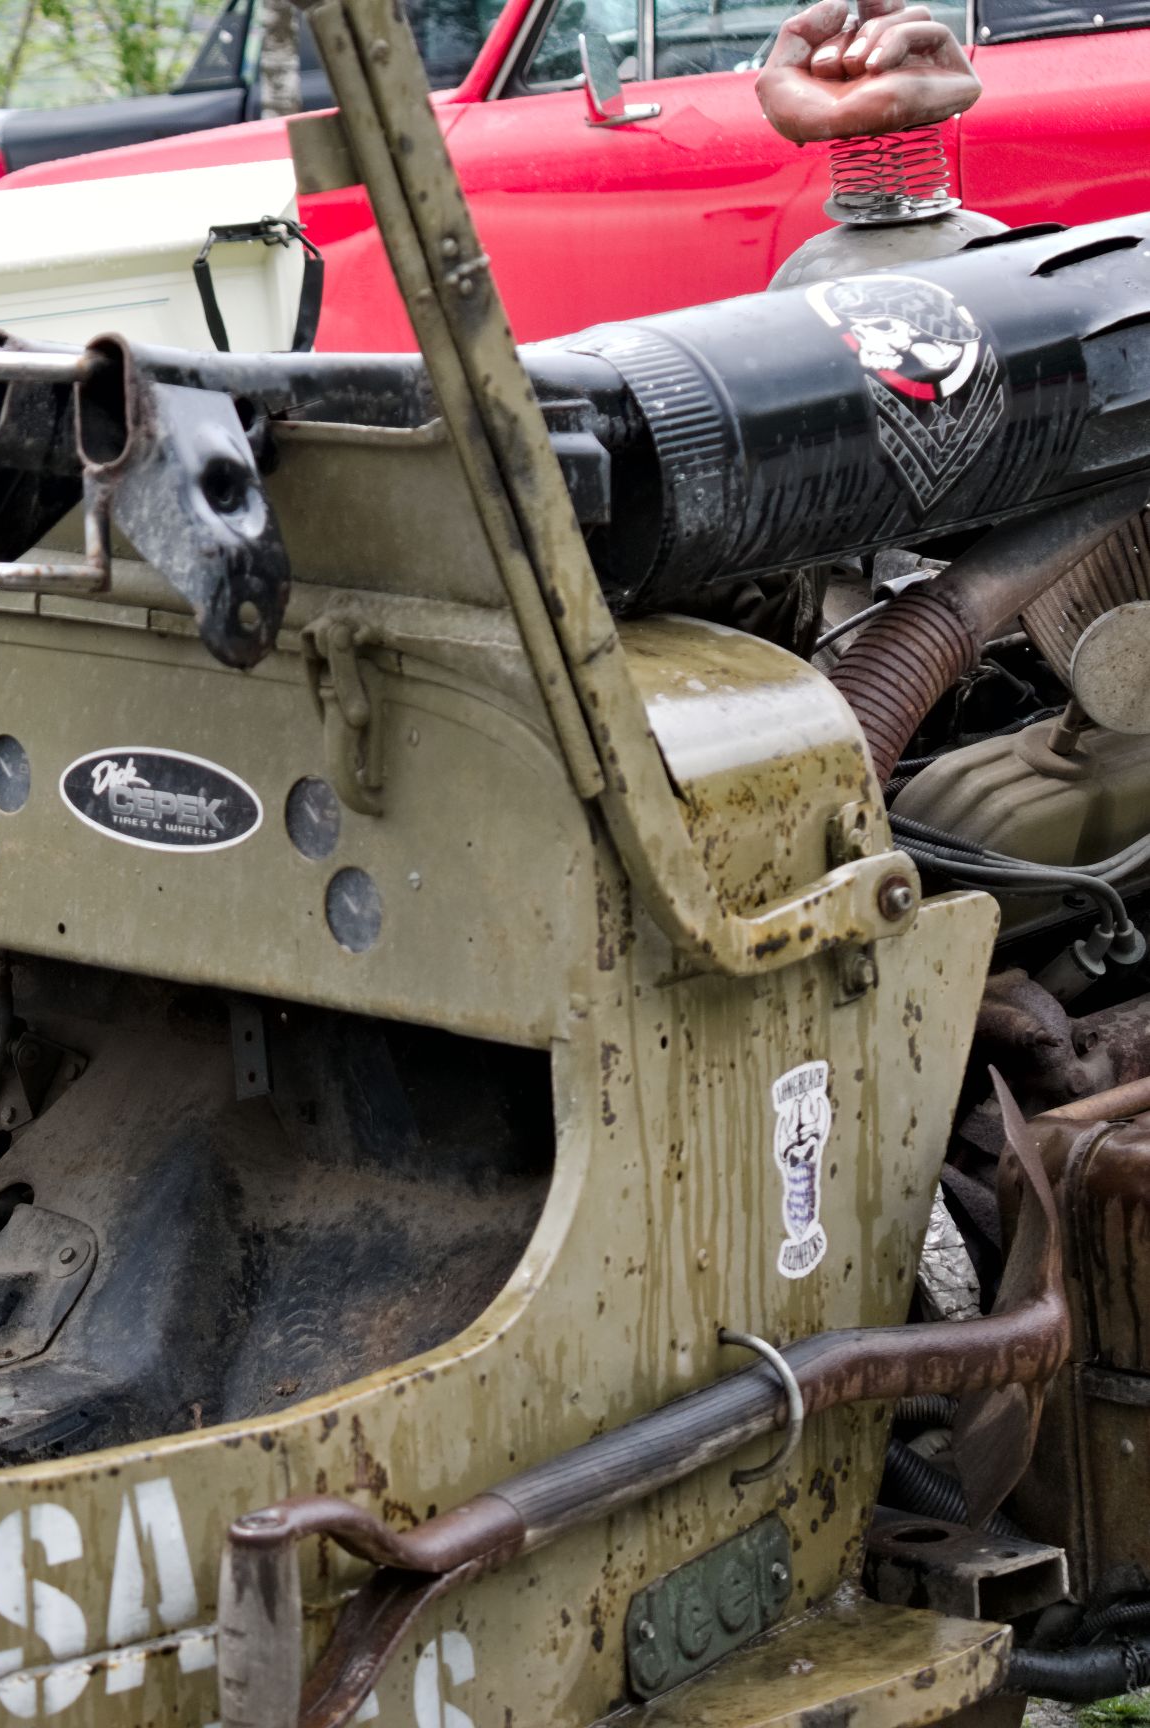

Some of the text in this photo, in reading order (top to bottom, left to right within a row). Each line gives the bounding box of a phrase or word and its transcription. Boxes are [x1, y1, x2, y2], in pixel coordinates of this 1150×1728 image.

[91, 757, 151, 796] Dick
[108, 784, 226, 831] CEPEK
[112, 815, 218, 838] TIRES & WHEELS
[781, 1231, 825, 1271] REDNECKS
